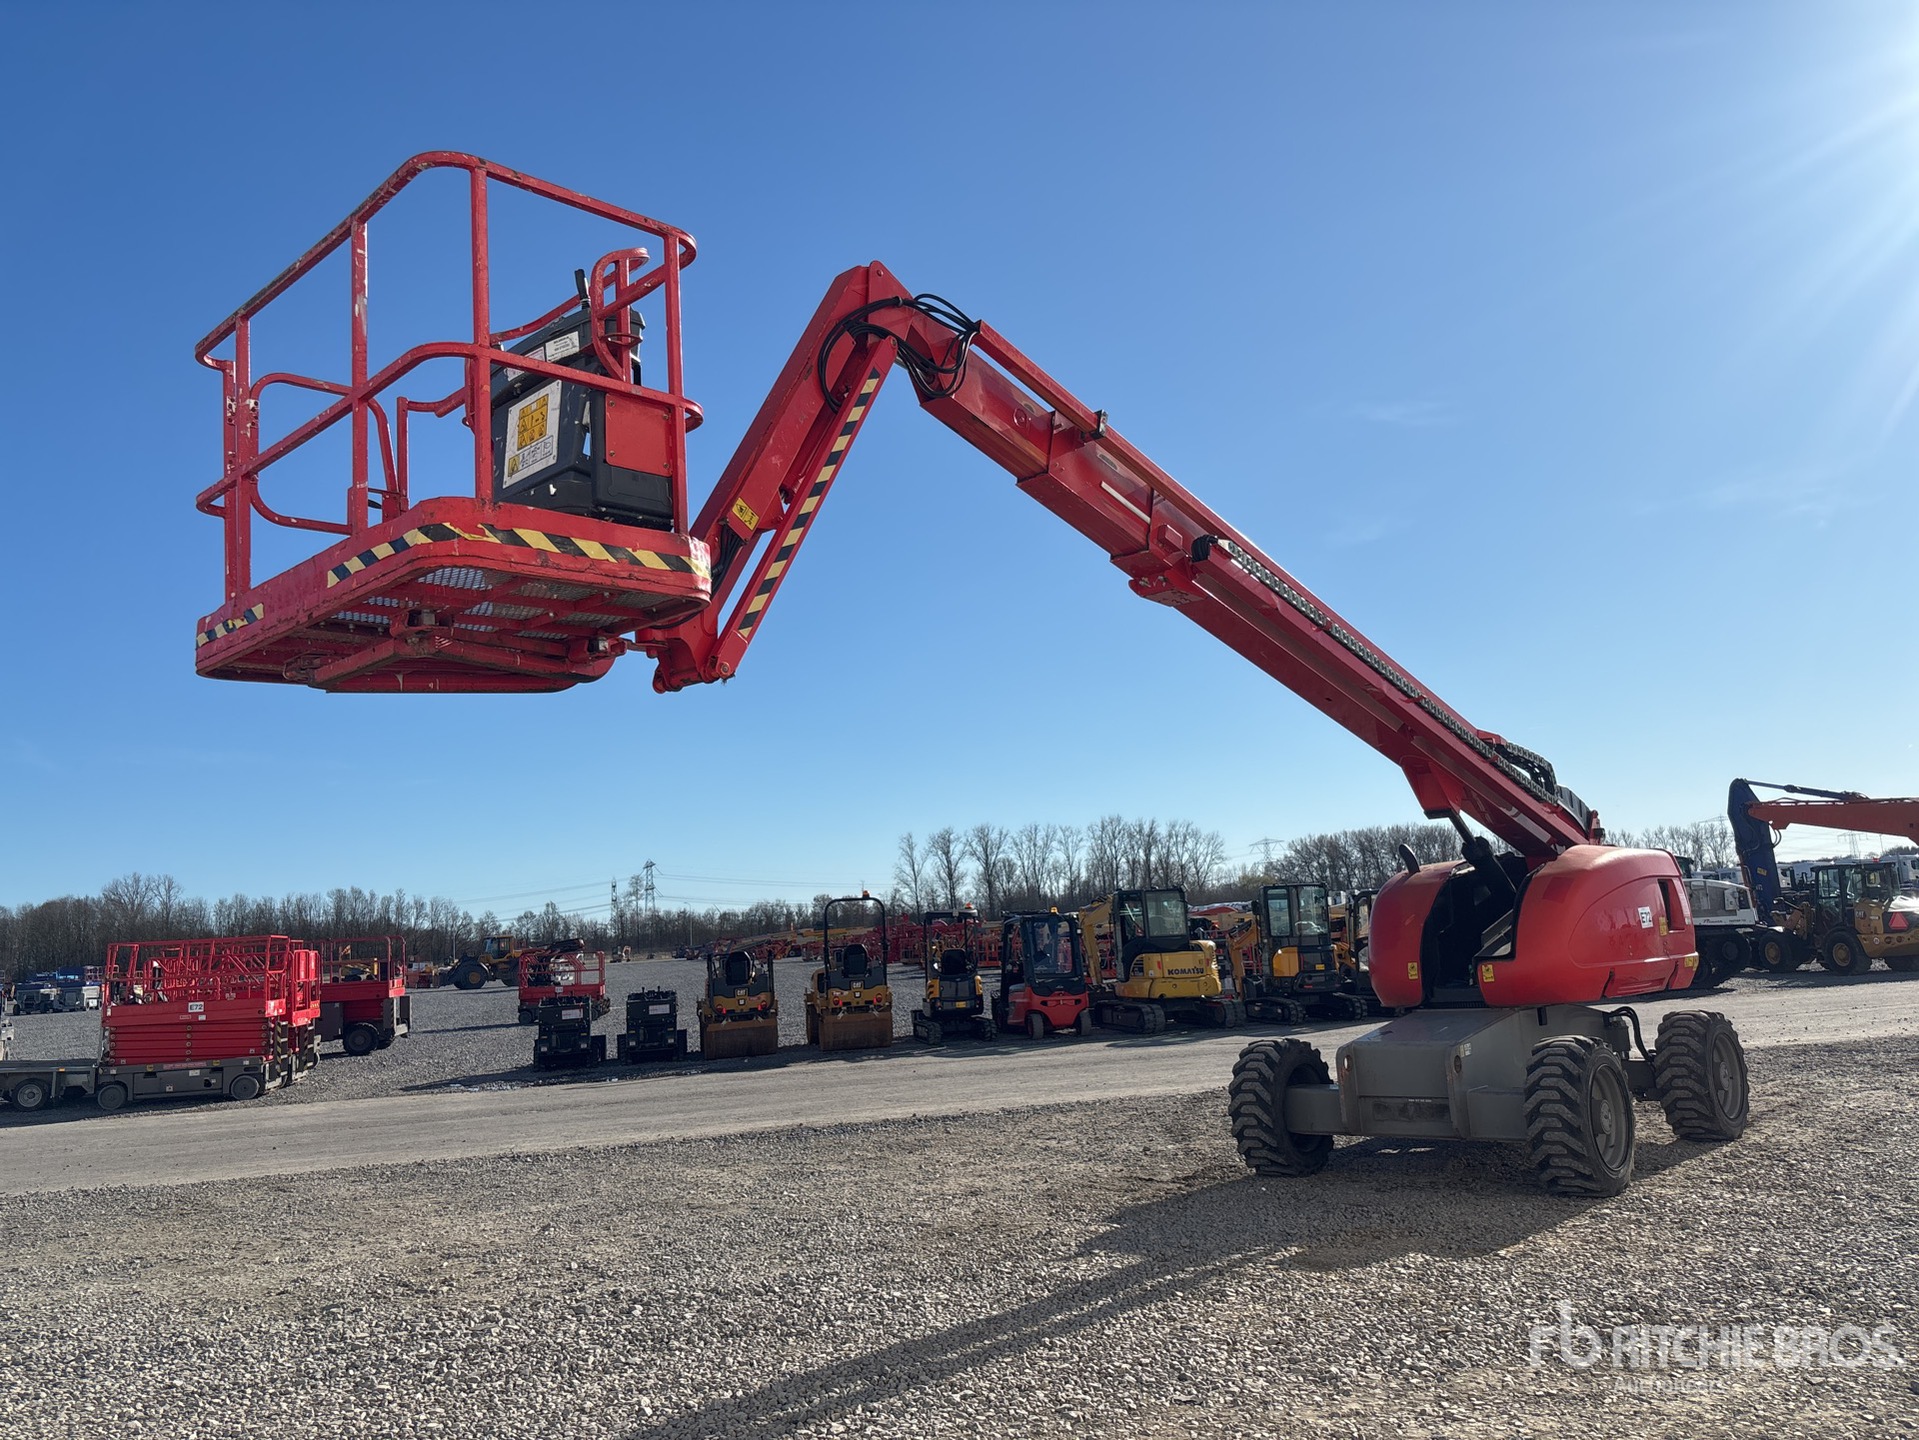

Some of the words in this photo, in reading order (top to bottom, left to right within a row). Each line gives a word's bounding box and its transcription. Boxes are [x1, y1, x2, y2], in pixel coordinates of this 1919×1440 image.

[1640, 911, 1652, 924] E72
[1167, 967, 1204, 975] KOMATSU
[189, 1003, 203, 1011] E72
